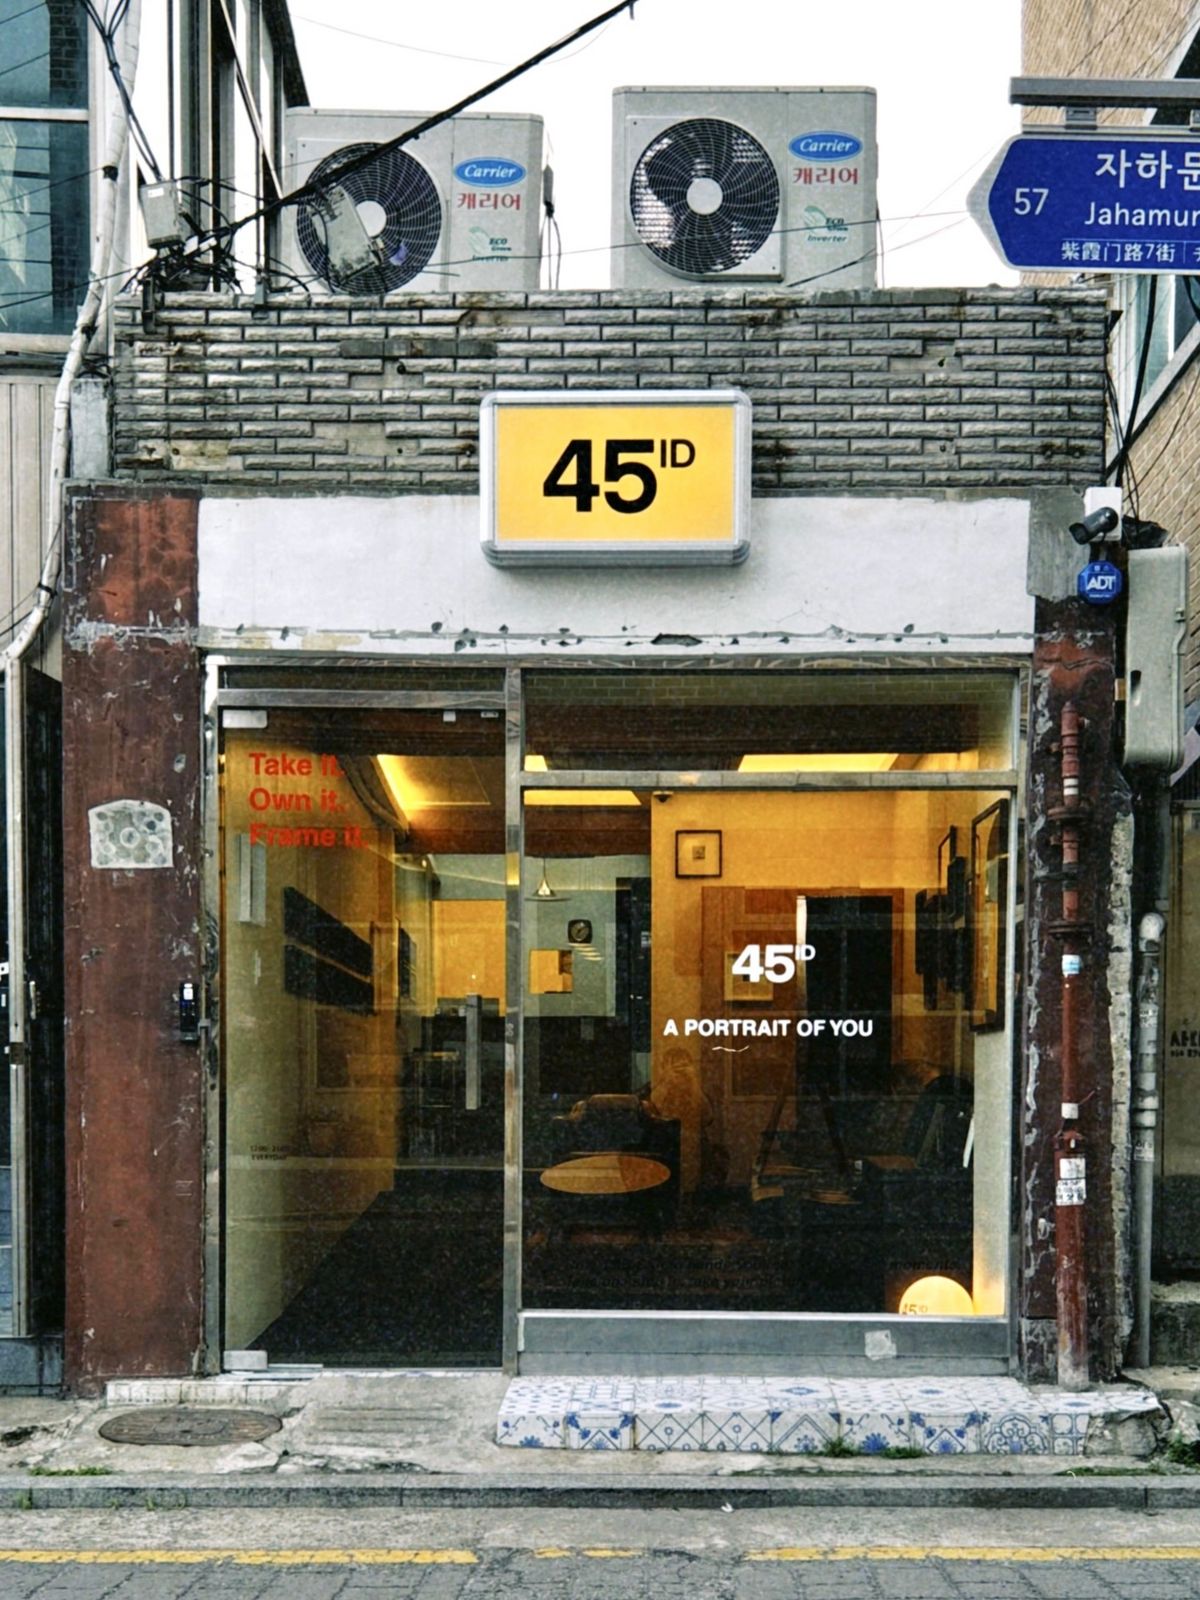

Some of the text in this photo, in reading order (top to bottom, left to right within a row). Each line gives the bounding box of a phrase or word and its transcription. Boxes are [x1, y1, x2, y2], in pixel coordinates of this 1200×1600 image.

[799, 138, 854, 153] Carrier
[464, 164, 517, 178] Carrier
[793, 167, 859, 185] 캐리어
[457, 192, 521, 211] 캐리어
[1013, 187, 1049, 216] 57
[1086, 575, 1116, 591] ADT
[249, 752, 312, 777] Take
[249, 787, 345, 812] Own it.
[249, 822, 336, 848] Frame
[663, 1019, 873, 1037] A PORTRAIT OF YOU
